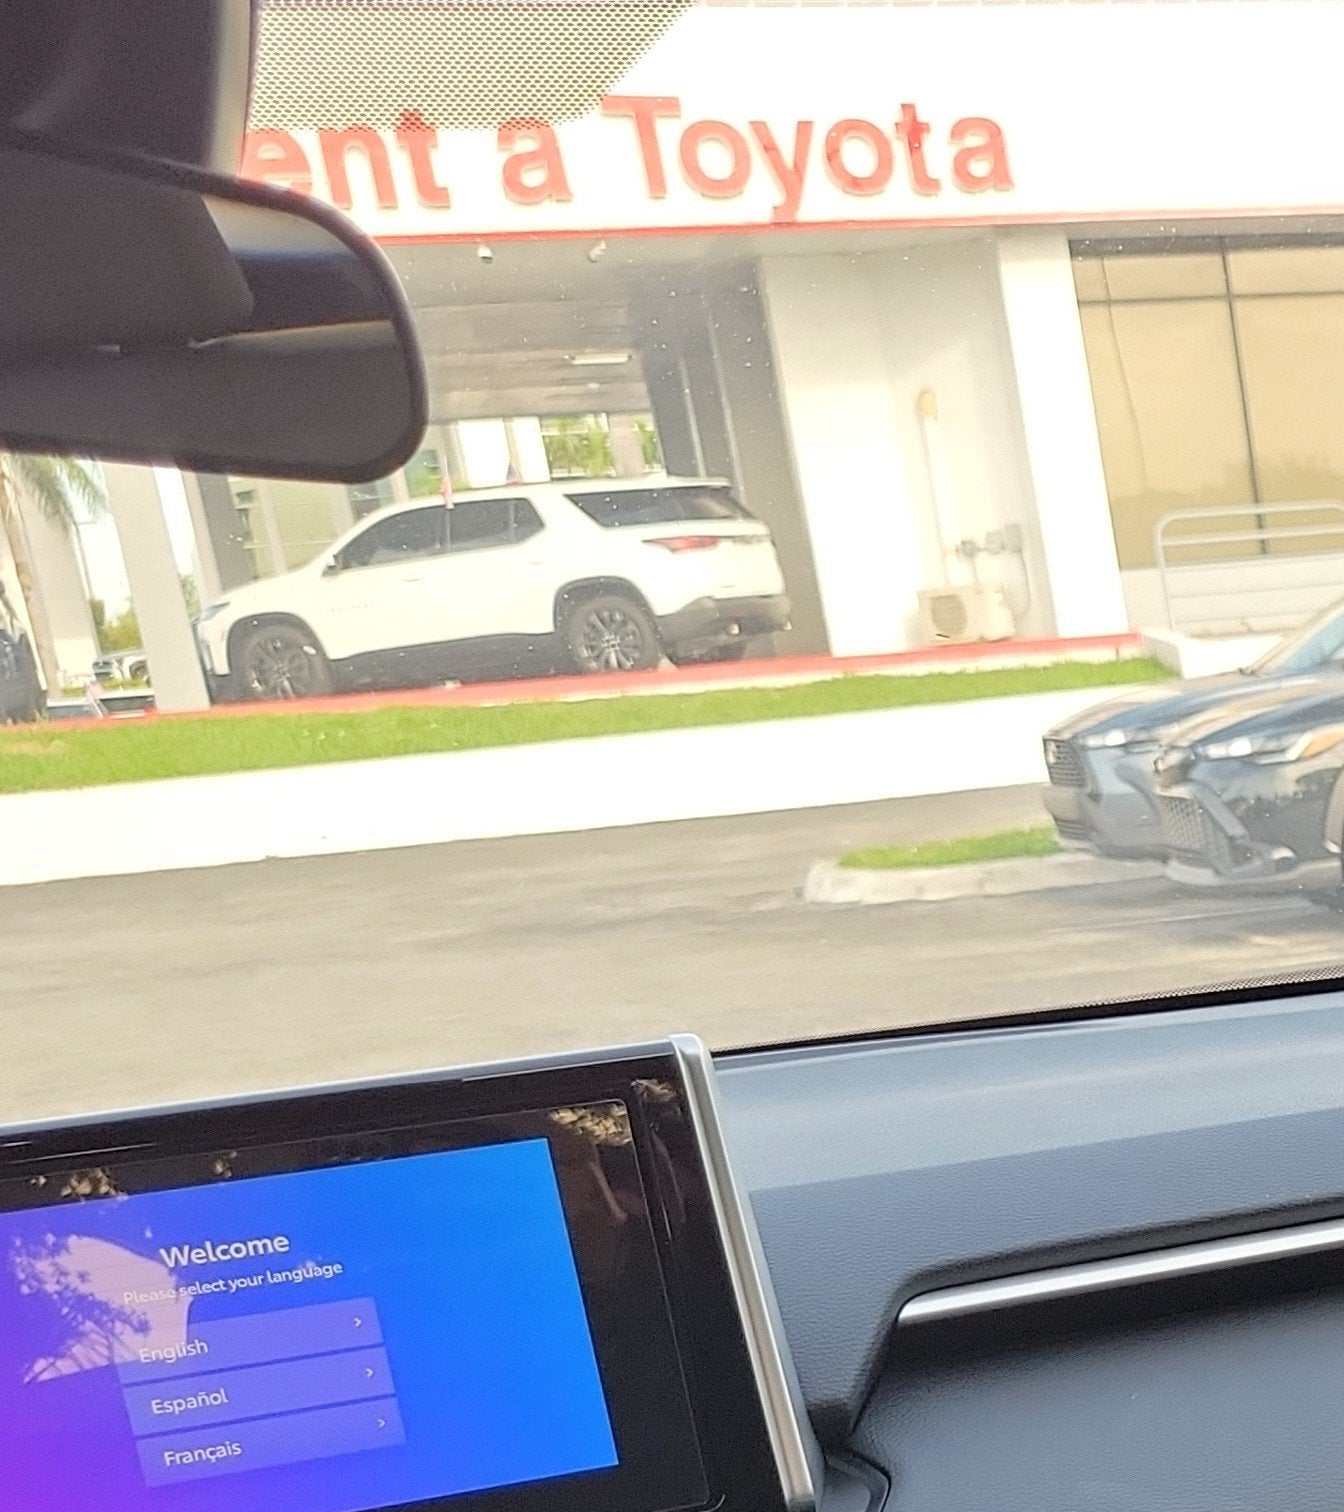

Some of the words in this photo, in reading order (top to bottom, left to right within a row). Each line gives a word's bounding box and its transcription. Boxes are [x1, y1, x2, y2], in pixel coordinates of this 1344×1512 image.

[500, 116, 577, 203] a
[600, 94, 1014, 224] Toyota
[159, 1234, 290, 1269] Welcome
[123, 1284, 177, 1306] Please
[178, 1276, 228, 1299] select
[227, 1274, 265, 1295] your
[265, 1261, 344, 1285] language
[138, 1338, 210, 1365] English
[150, 1387, 230, 1416] Español
[163, 1440, 243, 1467] Français
